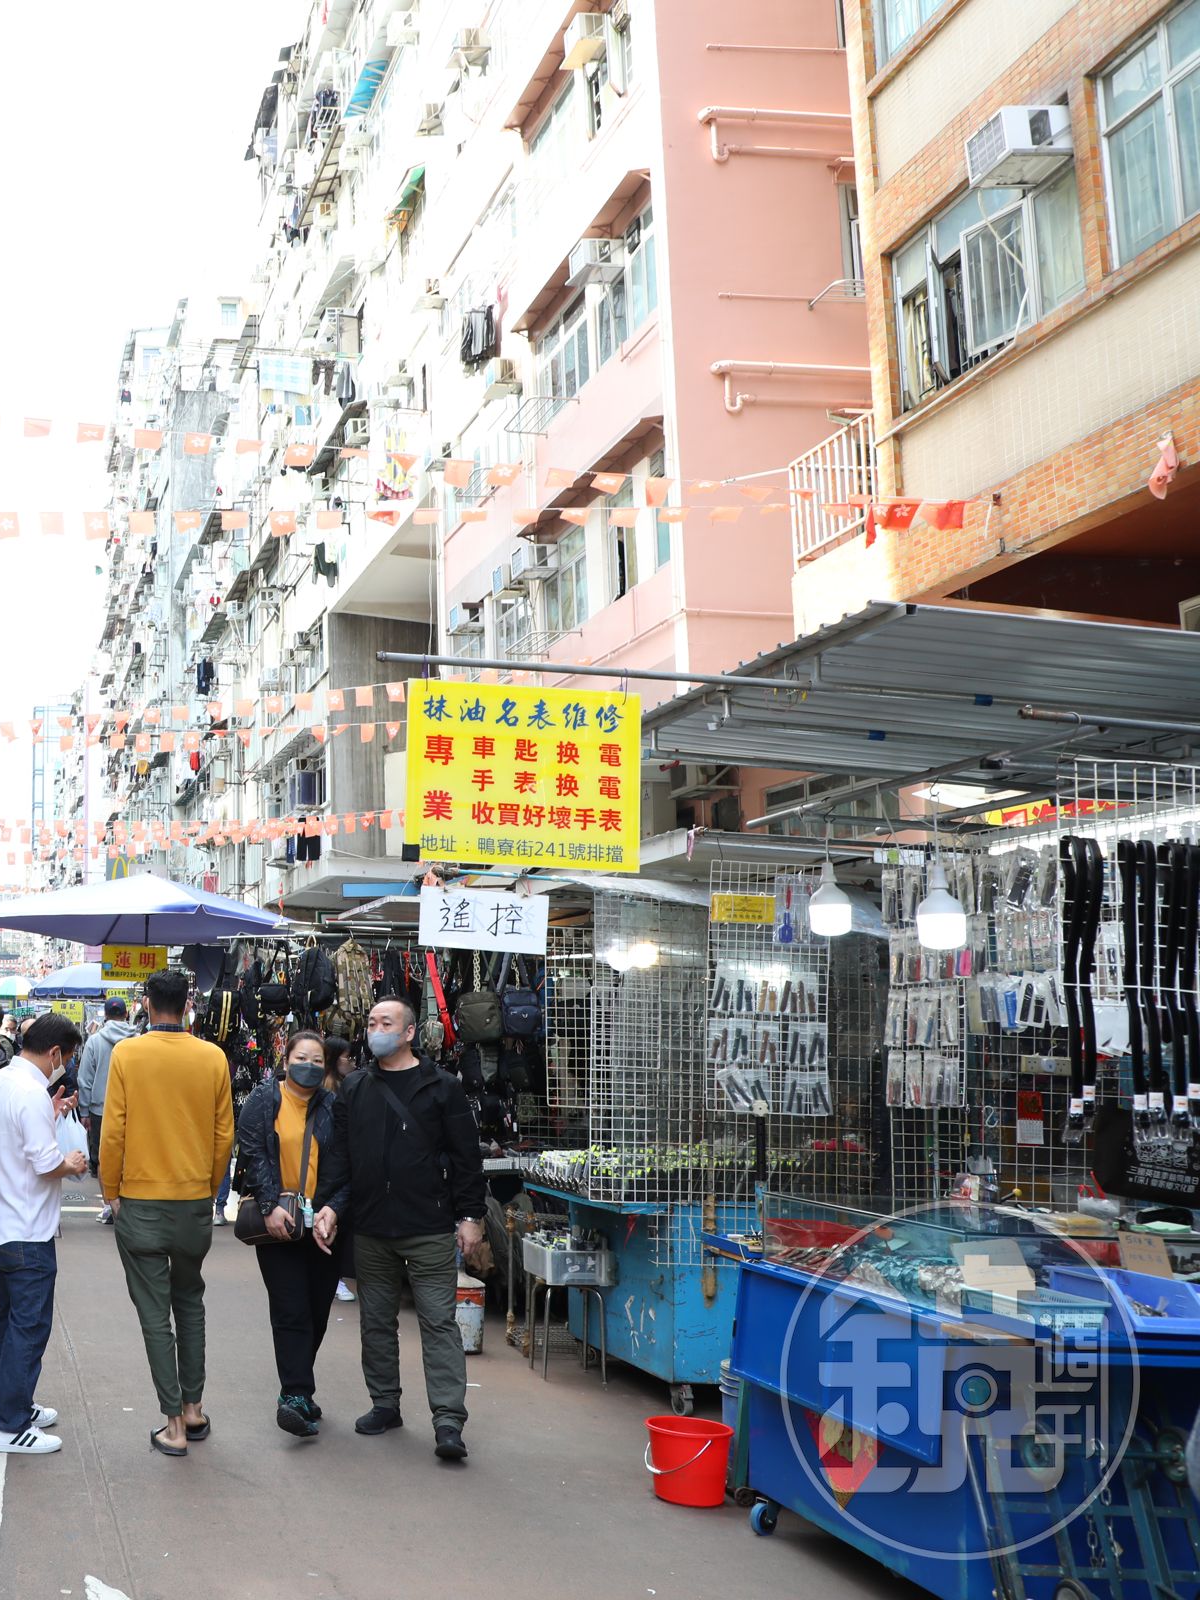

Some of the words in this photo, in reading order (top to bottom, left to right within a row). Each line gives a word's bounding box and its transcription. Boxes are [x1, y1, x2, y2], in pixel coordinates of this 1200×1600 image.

[423, 694, 624, 734] 抹油名表維修
[471, 735, 622, 768] 車匙換電
[471, 769, 622, 800] 手表換電
[471, 801, 623, 833] 收買好壞手表
[438, 897, 524, 937] 遙控
[113, 951, 156, 969] 蓮明
